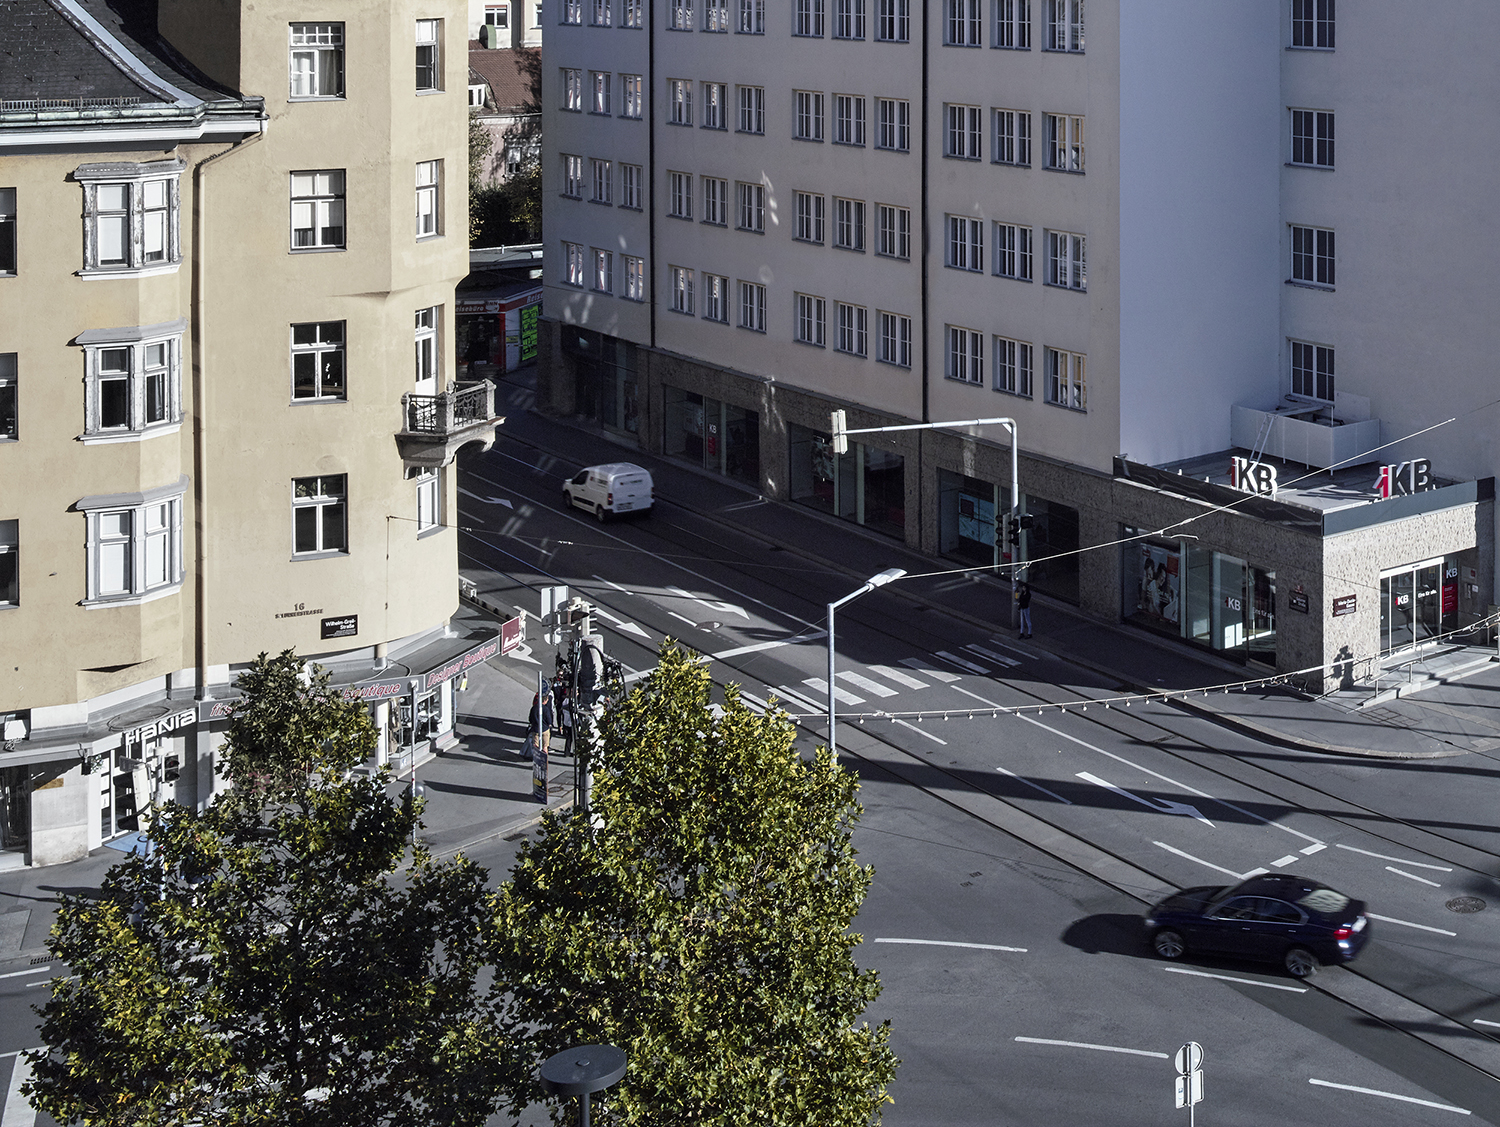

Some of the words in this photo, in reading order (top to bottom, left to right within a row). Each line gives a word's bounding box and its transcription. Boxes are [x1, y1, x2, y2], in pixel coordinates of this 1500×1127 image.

[294, 603, 305, 611] 16
[426, 660, 463, 688] Designer
[462, 642, 497, 669] Boutique
[210, 702, 236, 717] firs
